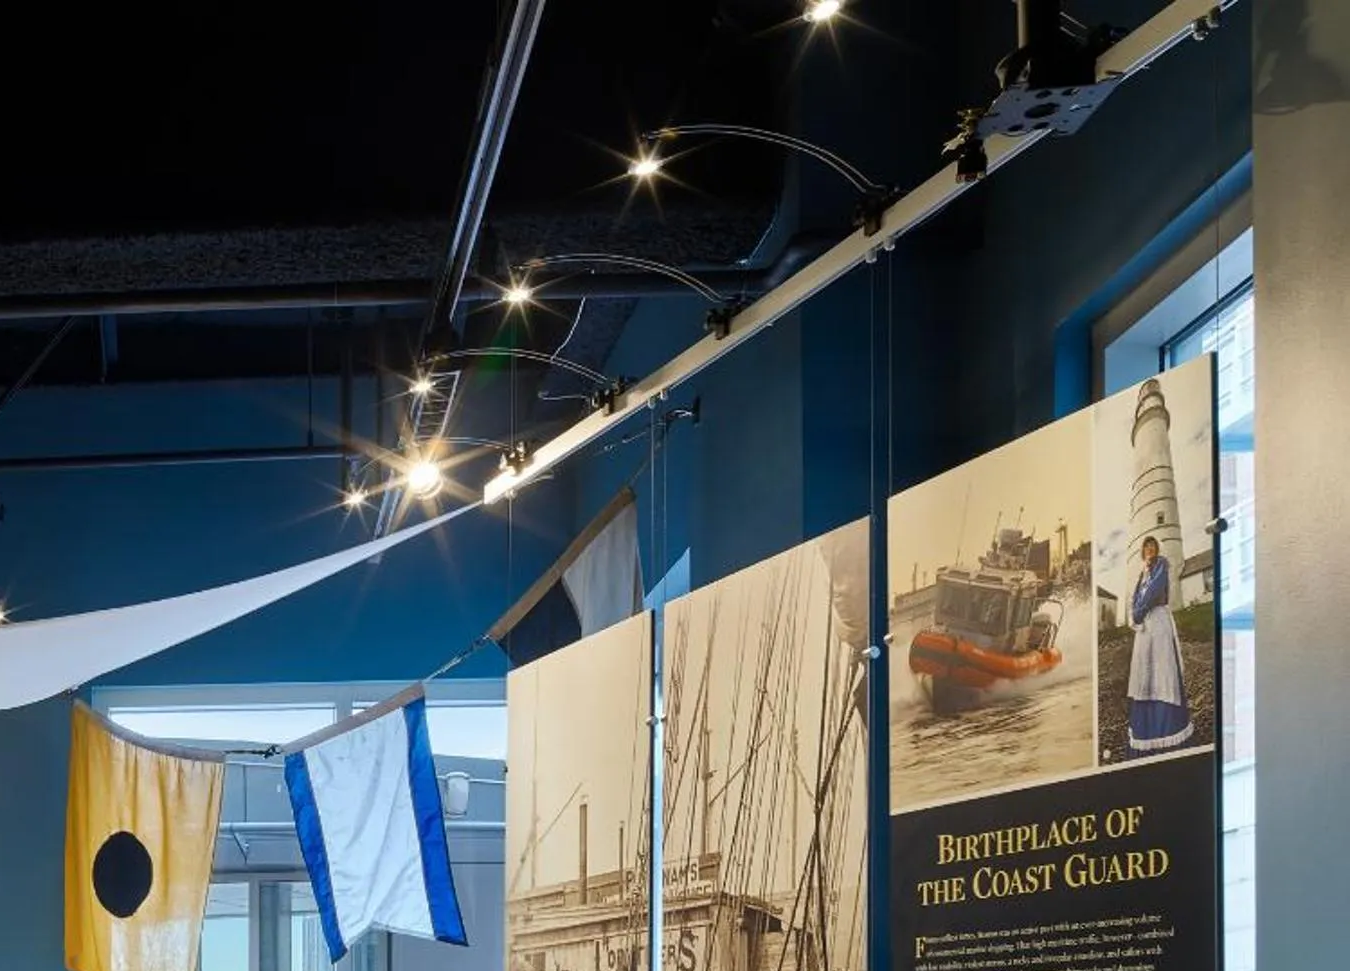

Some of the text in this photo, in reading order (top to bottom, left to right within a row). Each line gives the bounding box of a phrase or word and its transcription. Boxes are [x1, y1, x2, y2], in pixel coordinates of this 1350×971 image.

[937, 805, 1144, 865] BIRTHPLACE OF
[917, 848, 1169, 906] THE COAST GUARD
